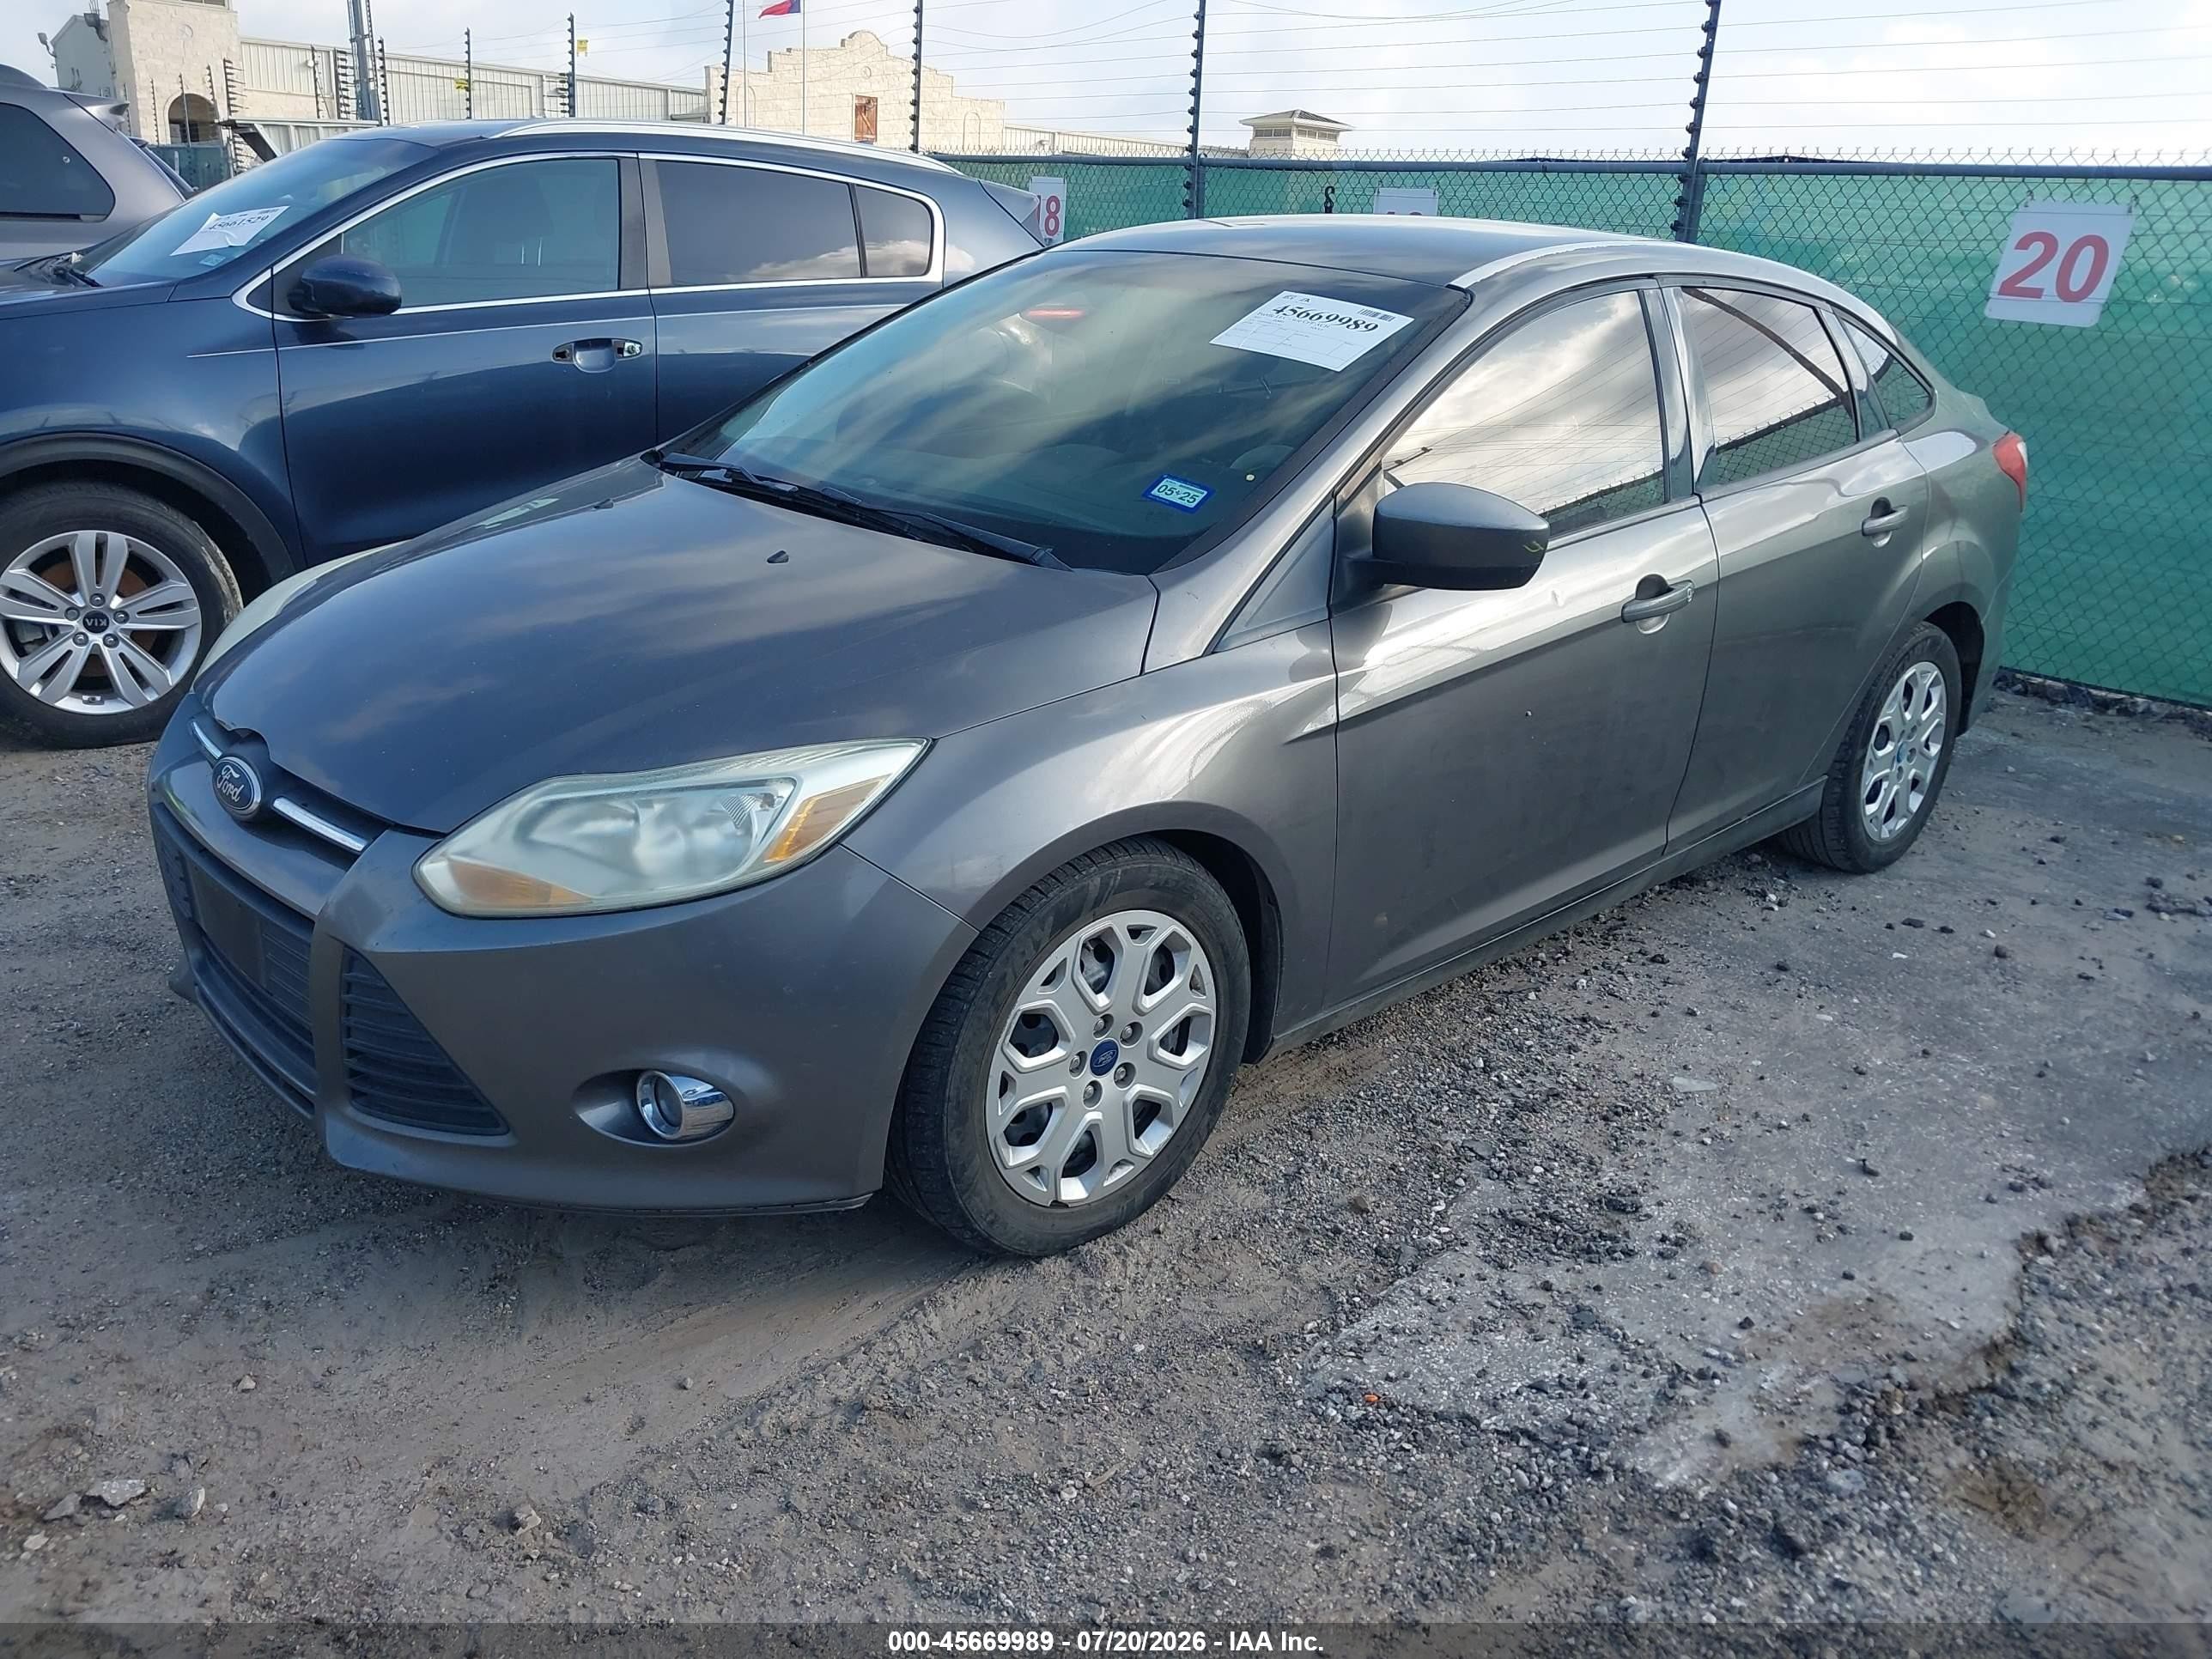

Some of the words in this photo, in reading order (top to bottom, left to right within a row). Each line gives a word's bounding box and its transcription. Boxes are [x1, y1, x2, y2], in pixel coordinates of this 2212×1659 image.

[1998, 231, 2109, 302] 20
[1273, 304, 1378, 333] 45669989
[86, 617, 107, 627] KIA
[216, 764, 245, 802] Ford
